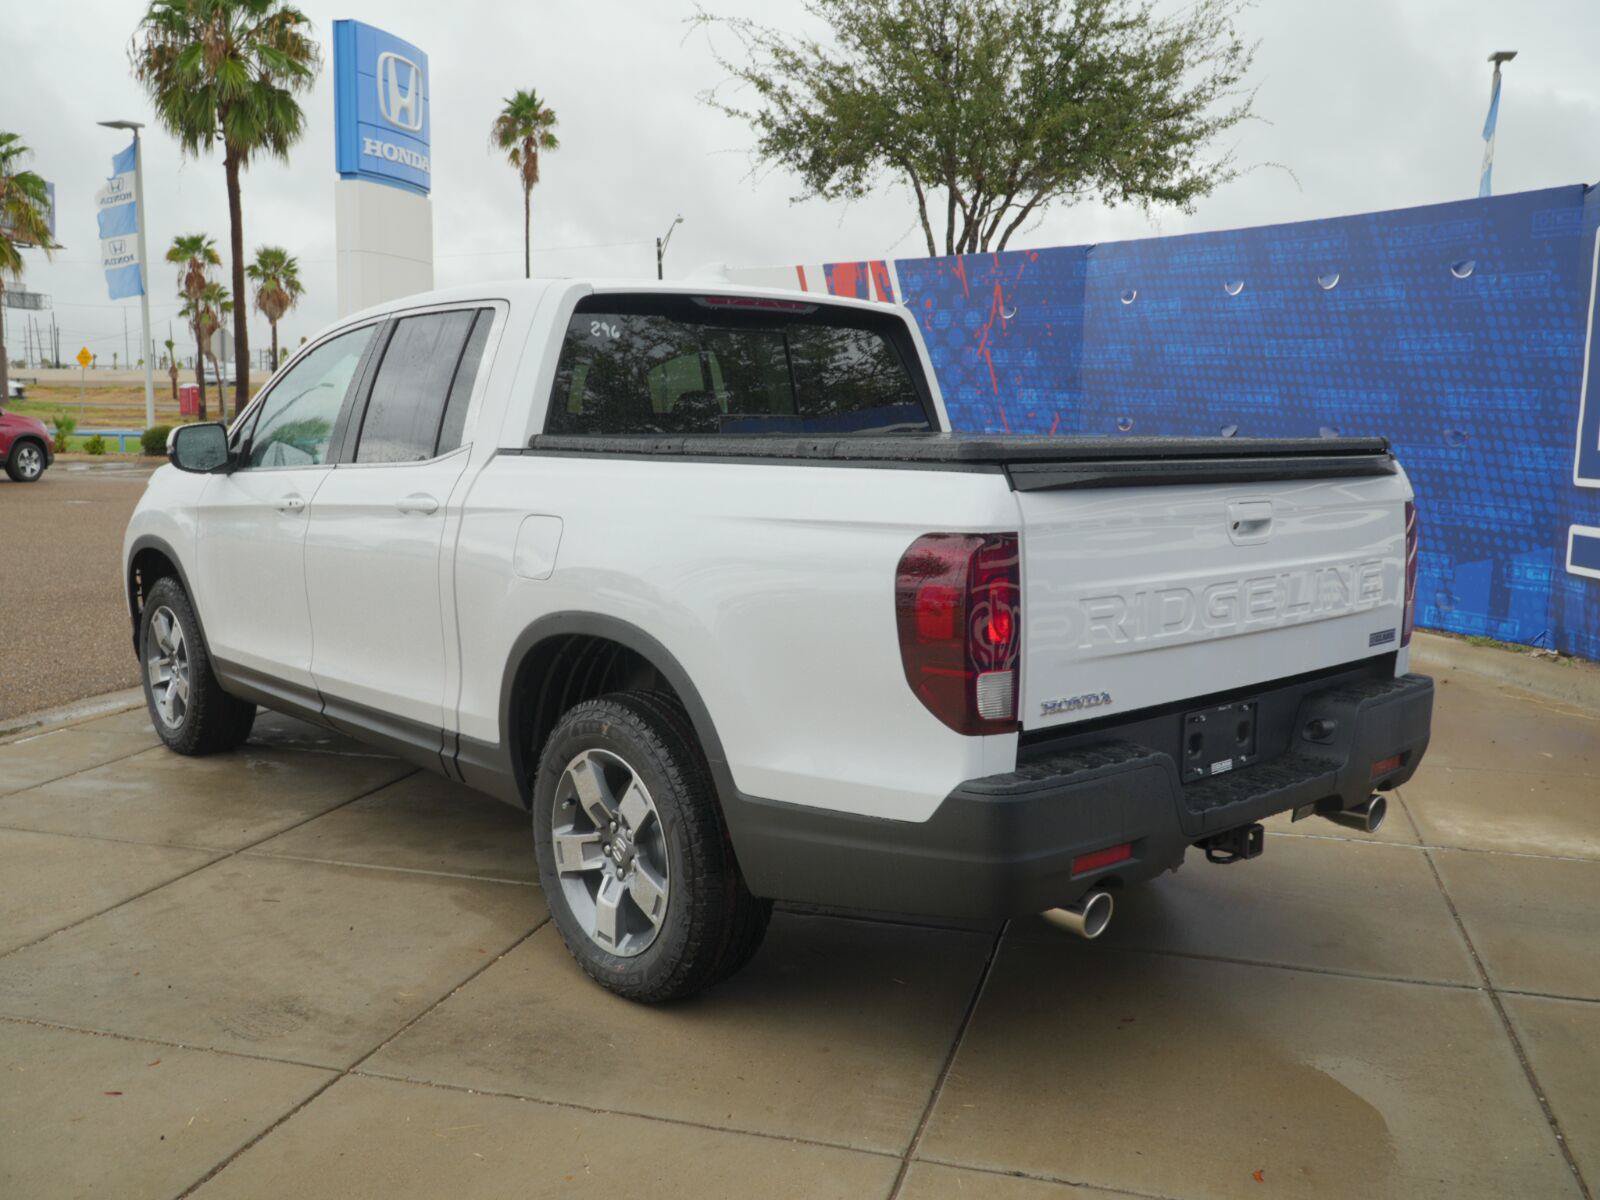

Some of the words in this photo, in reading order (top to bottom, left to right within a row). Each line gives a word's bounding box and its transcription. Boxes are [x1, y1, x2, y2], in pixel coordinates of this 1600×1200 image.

[362, 137, 431, 174] HONDA
[590, 320, 621, 338] 296
[1077, 559, 1385, 648] RIDGELINE
[1040, 691, 1112, 716] HONDA
